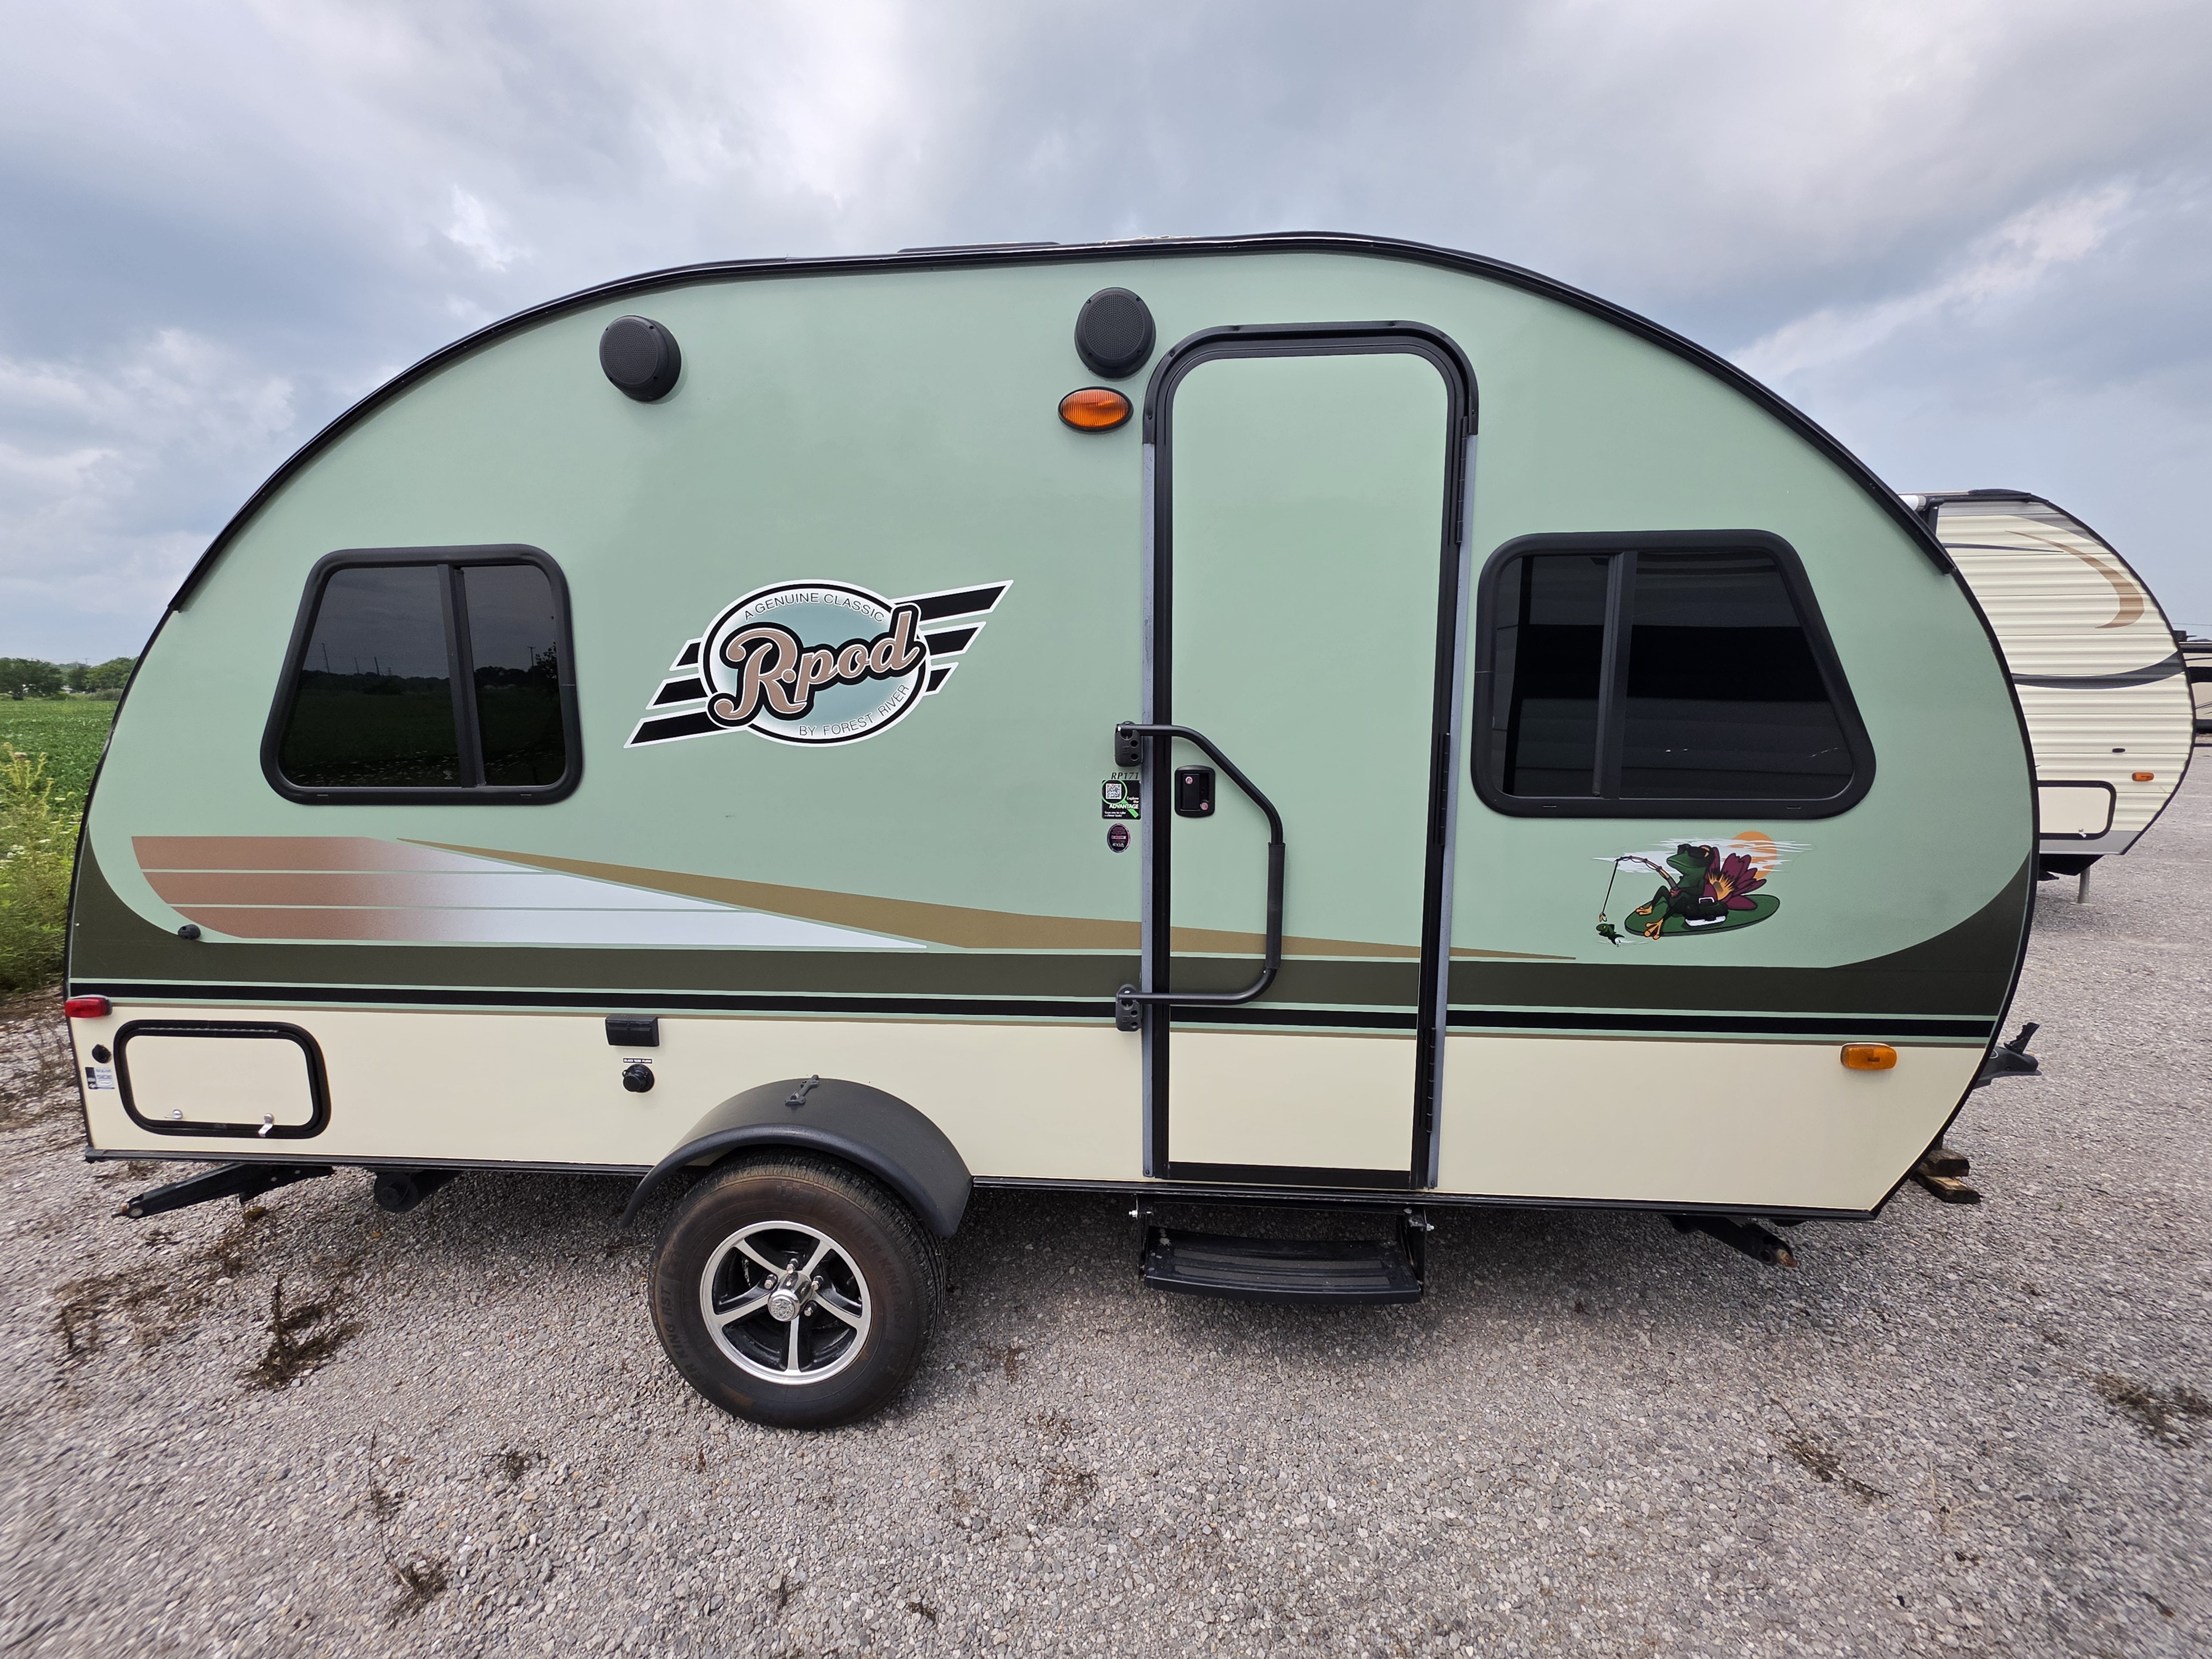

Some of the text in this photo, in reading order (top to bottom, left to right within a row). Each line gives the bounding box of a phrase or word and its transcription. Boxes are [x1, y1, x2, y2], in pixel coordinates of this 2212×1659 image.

[744, 593, 885, 623] A GENUINE CLASSIC
[799, 684, 910, 736] BY FOREST RIVER
[661, 1286, 688, 1359] KING RST
